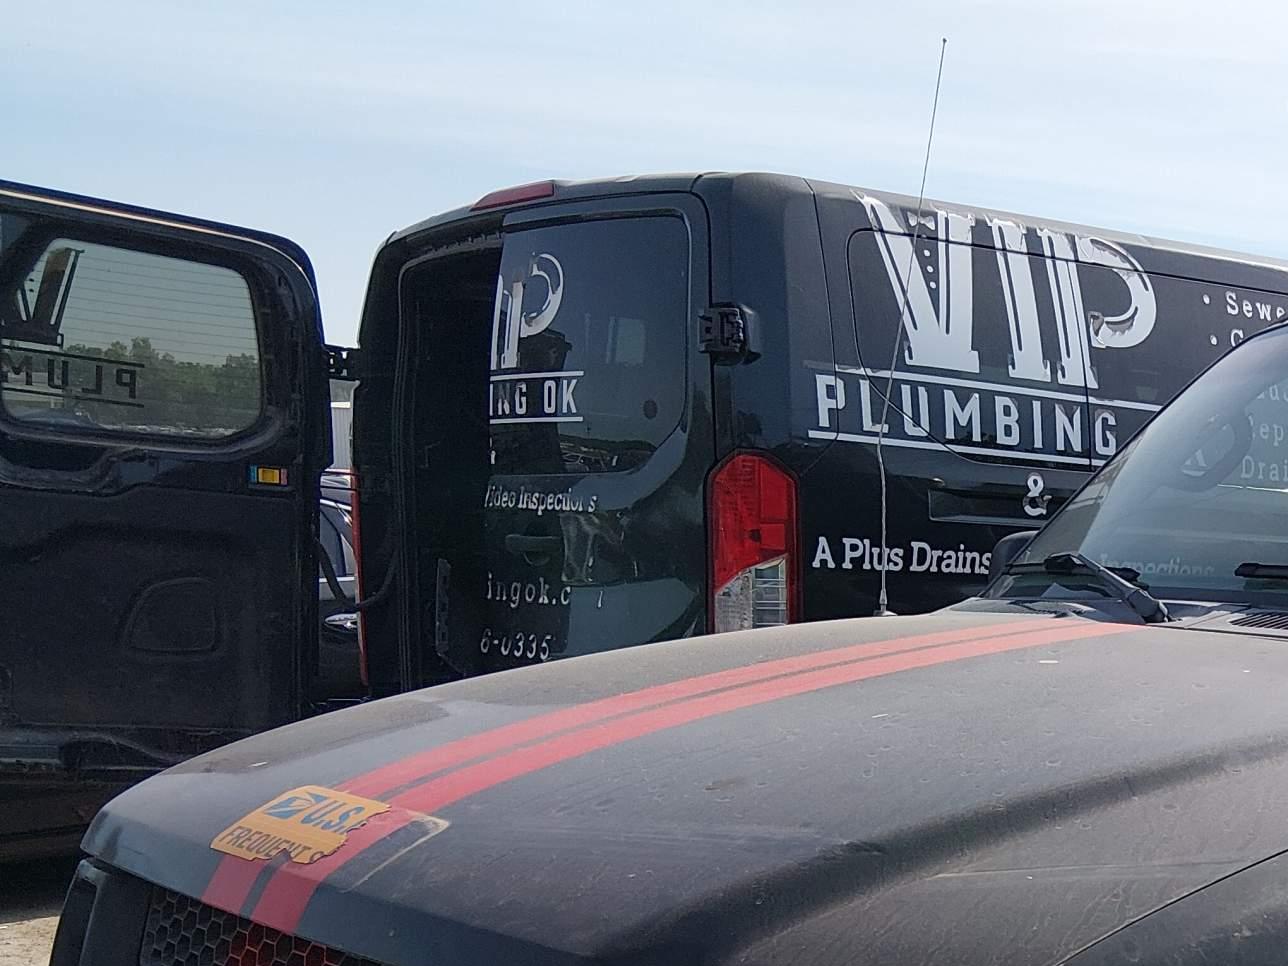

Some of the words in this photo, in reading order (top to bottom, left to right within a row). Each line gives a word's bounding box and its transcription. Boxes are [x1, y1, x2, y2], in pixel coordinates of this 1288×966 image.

[855, 191, 1158, 390] VIP
[543, 379, 579, 415] OK
[813, 373, 1118, 457] PLUMBING
[1022, 473, 1053, 517] &
[812, 536, 836, 570] A
[841, 537, 904, 573] Plus
[909, 540, 992, 576] Drains
